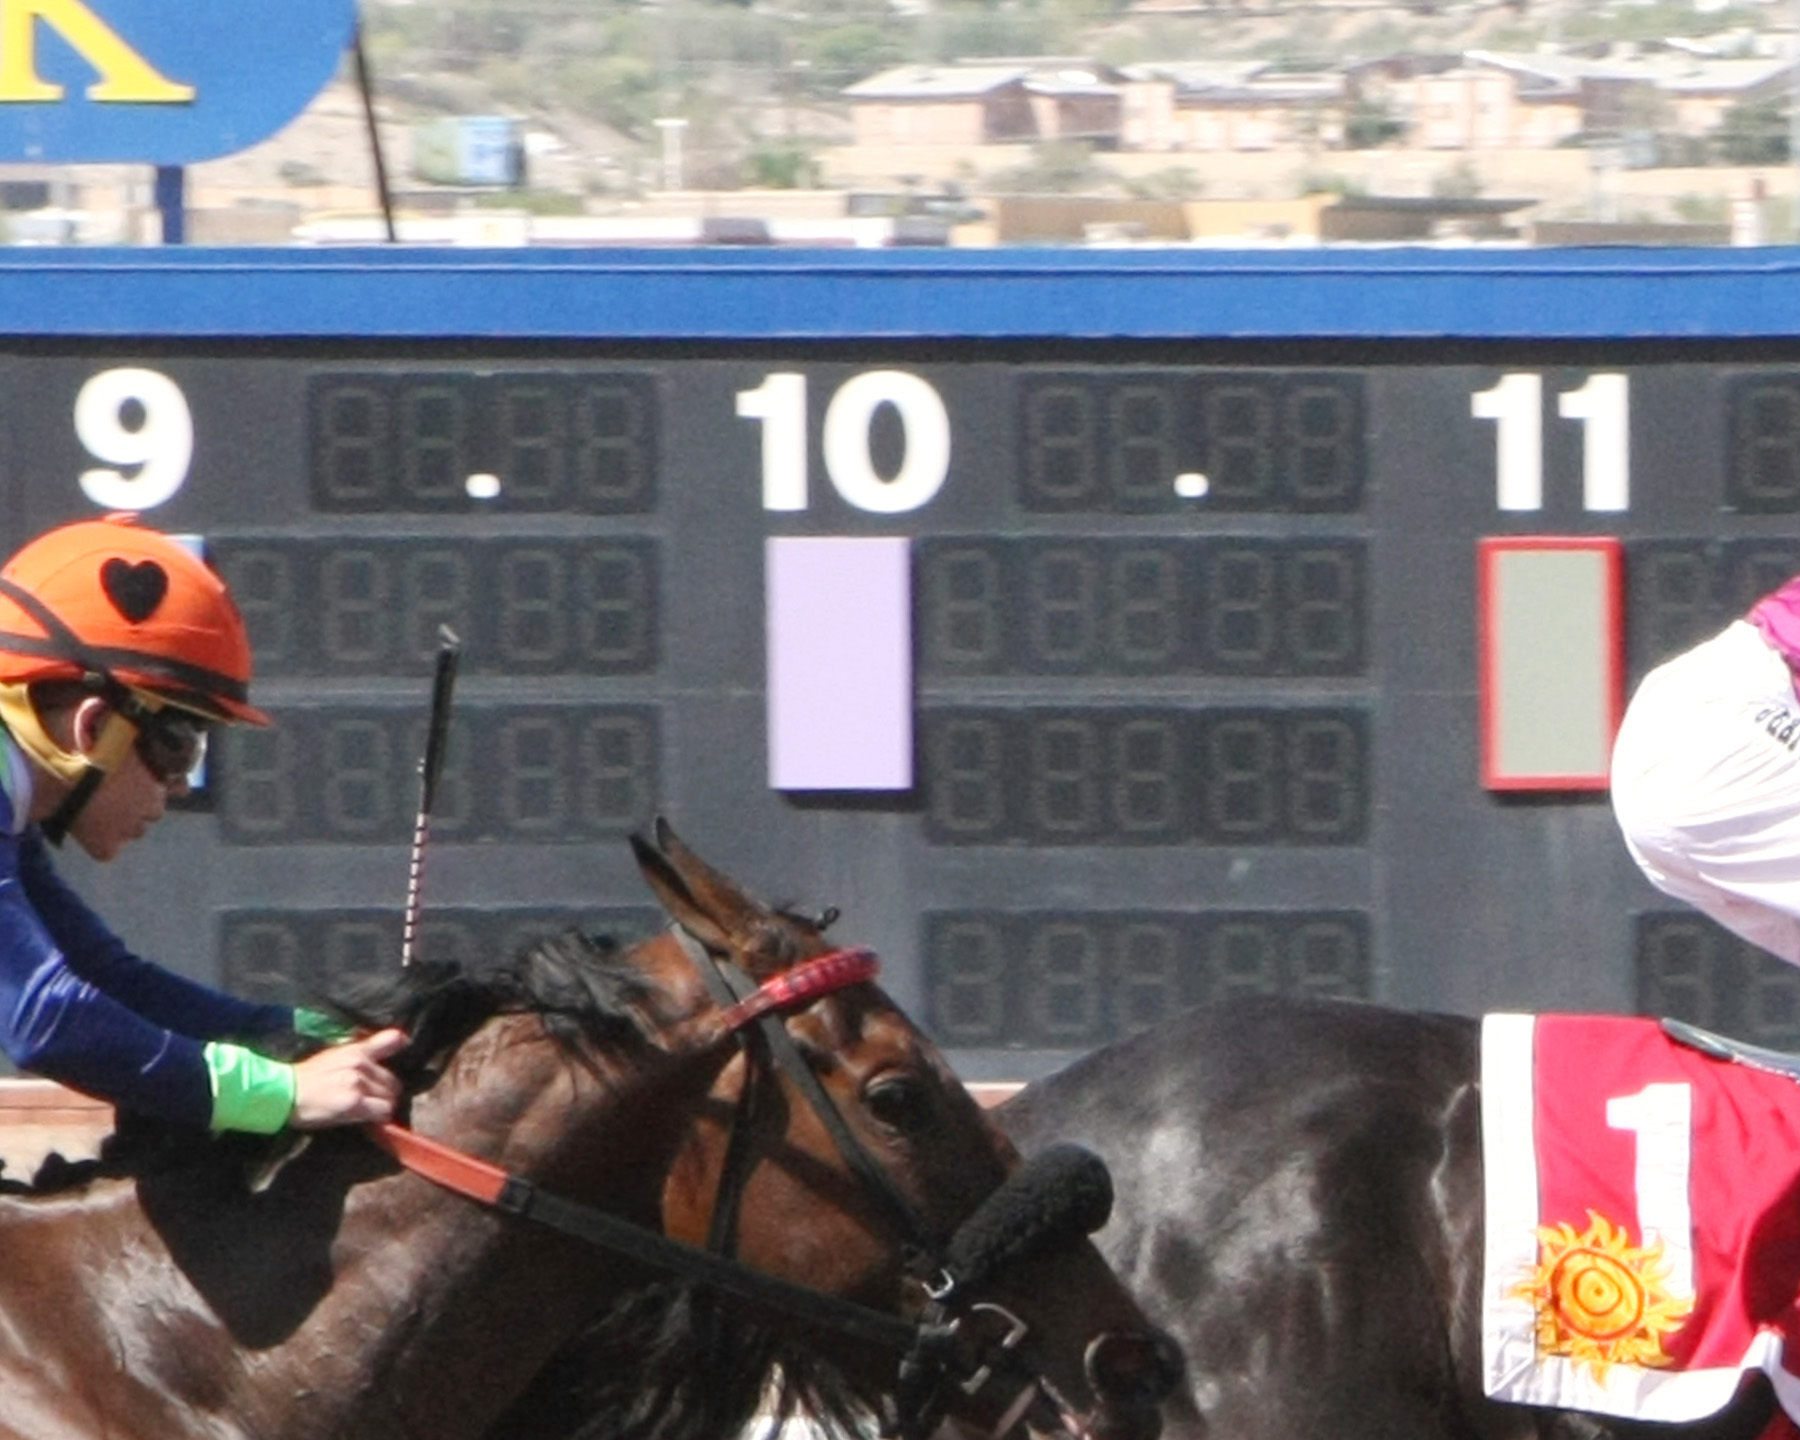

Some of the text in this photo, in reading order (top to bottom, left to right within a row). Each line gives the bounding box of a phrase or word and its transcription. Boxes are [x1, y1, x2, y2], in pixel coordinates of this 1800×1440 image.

[72, 367, 194, 511] 9
[734, 370, 952, 513] 10
[1470, 372, 1631, 512] 11
[1606, 1082, 1695, 1313] 1
